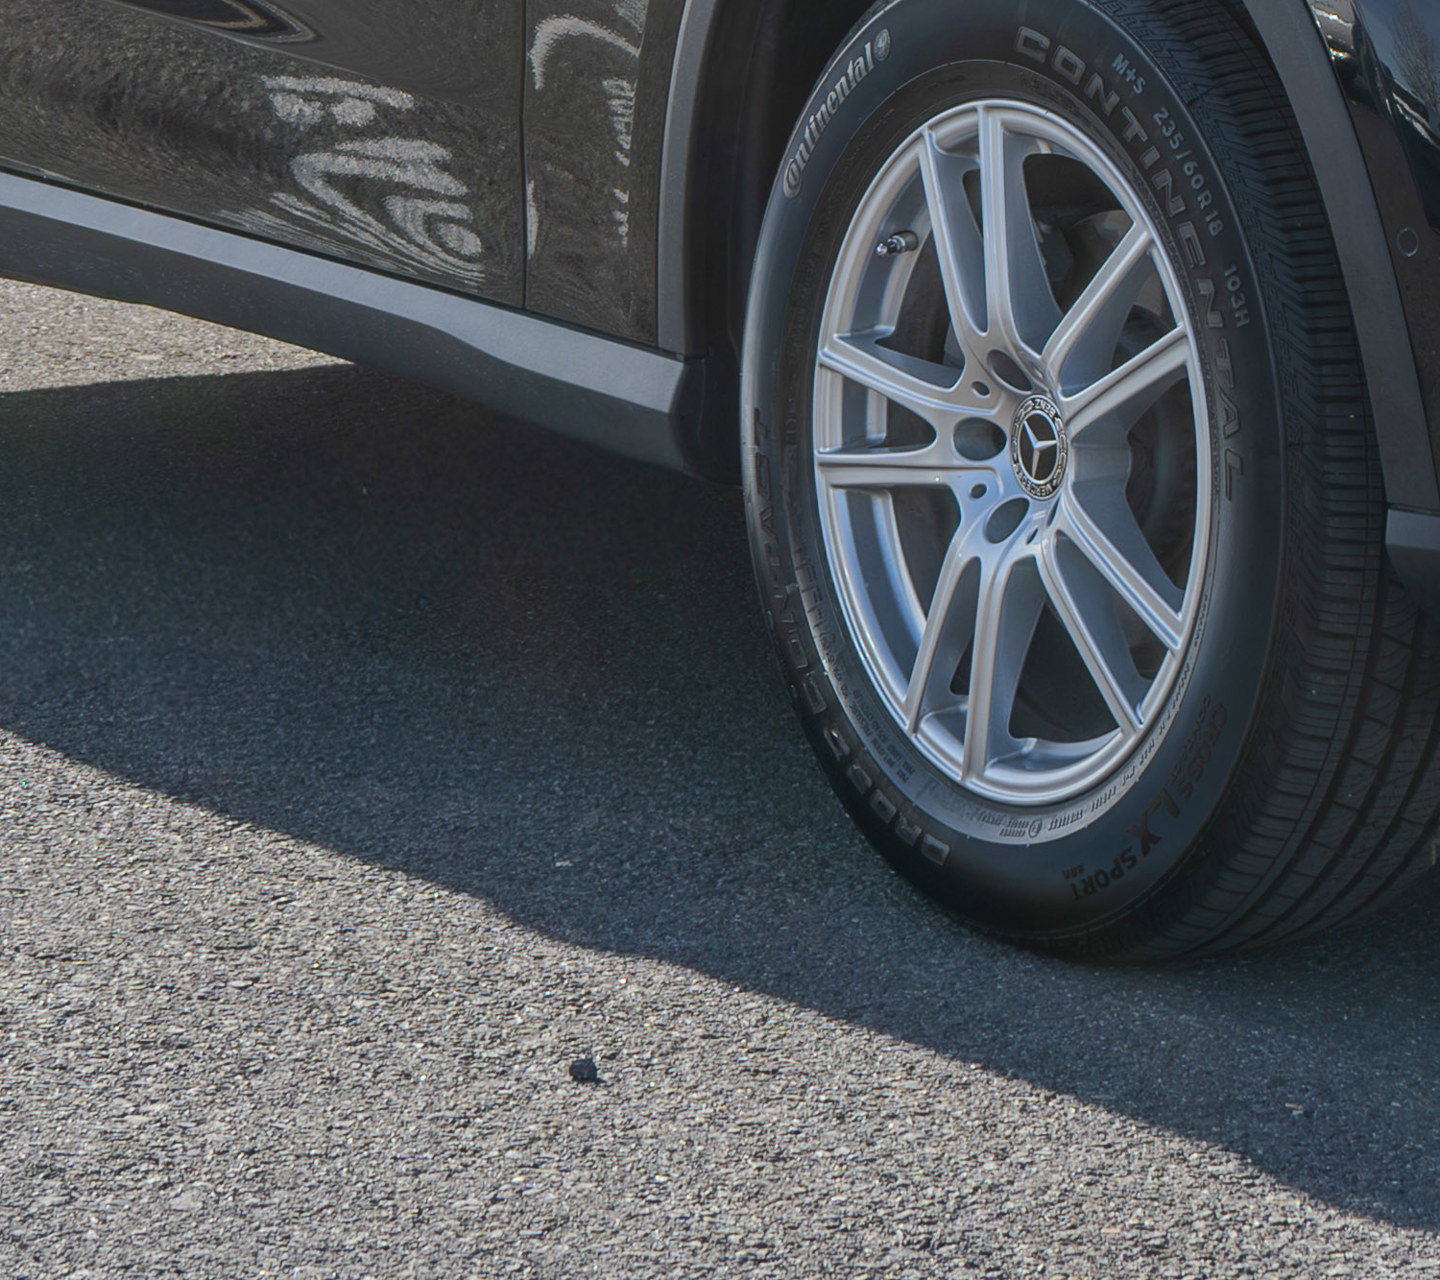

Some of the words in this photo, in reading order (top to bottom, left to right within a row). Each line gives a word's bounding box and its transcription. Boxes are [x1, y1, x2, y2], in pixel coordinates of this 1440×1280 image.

[782, 41, 875, 199] Continental
[1111, 53, 1146, 95] M+S
[1224, 264, 1250, 328] 103H
[1016, 25, 1244, 502] CONTINENTAL
[1070, 846, 1138, 902] SPORT
